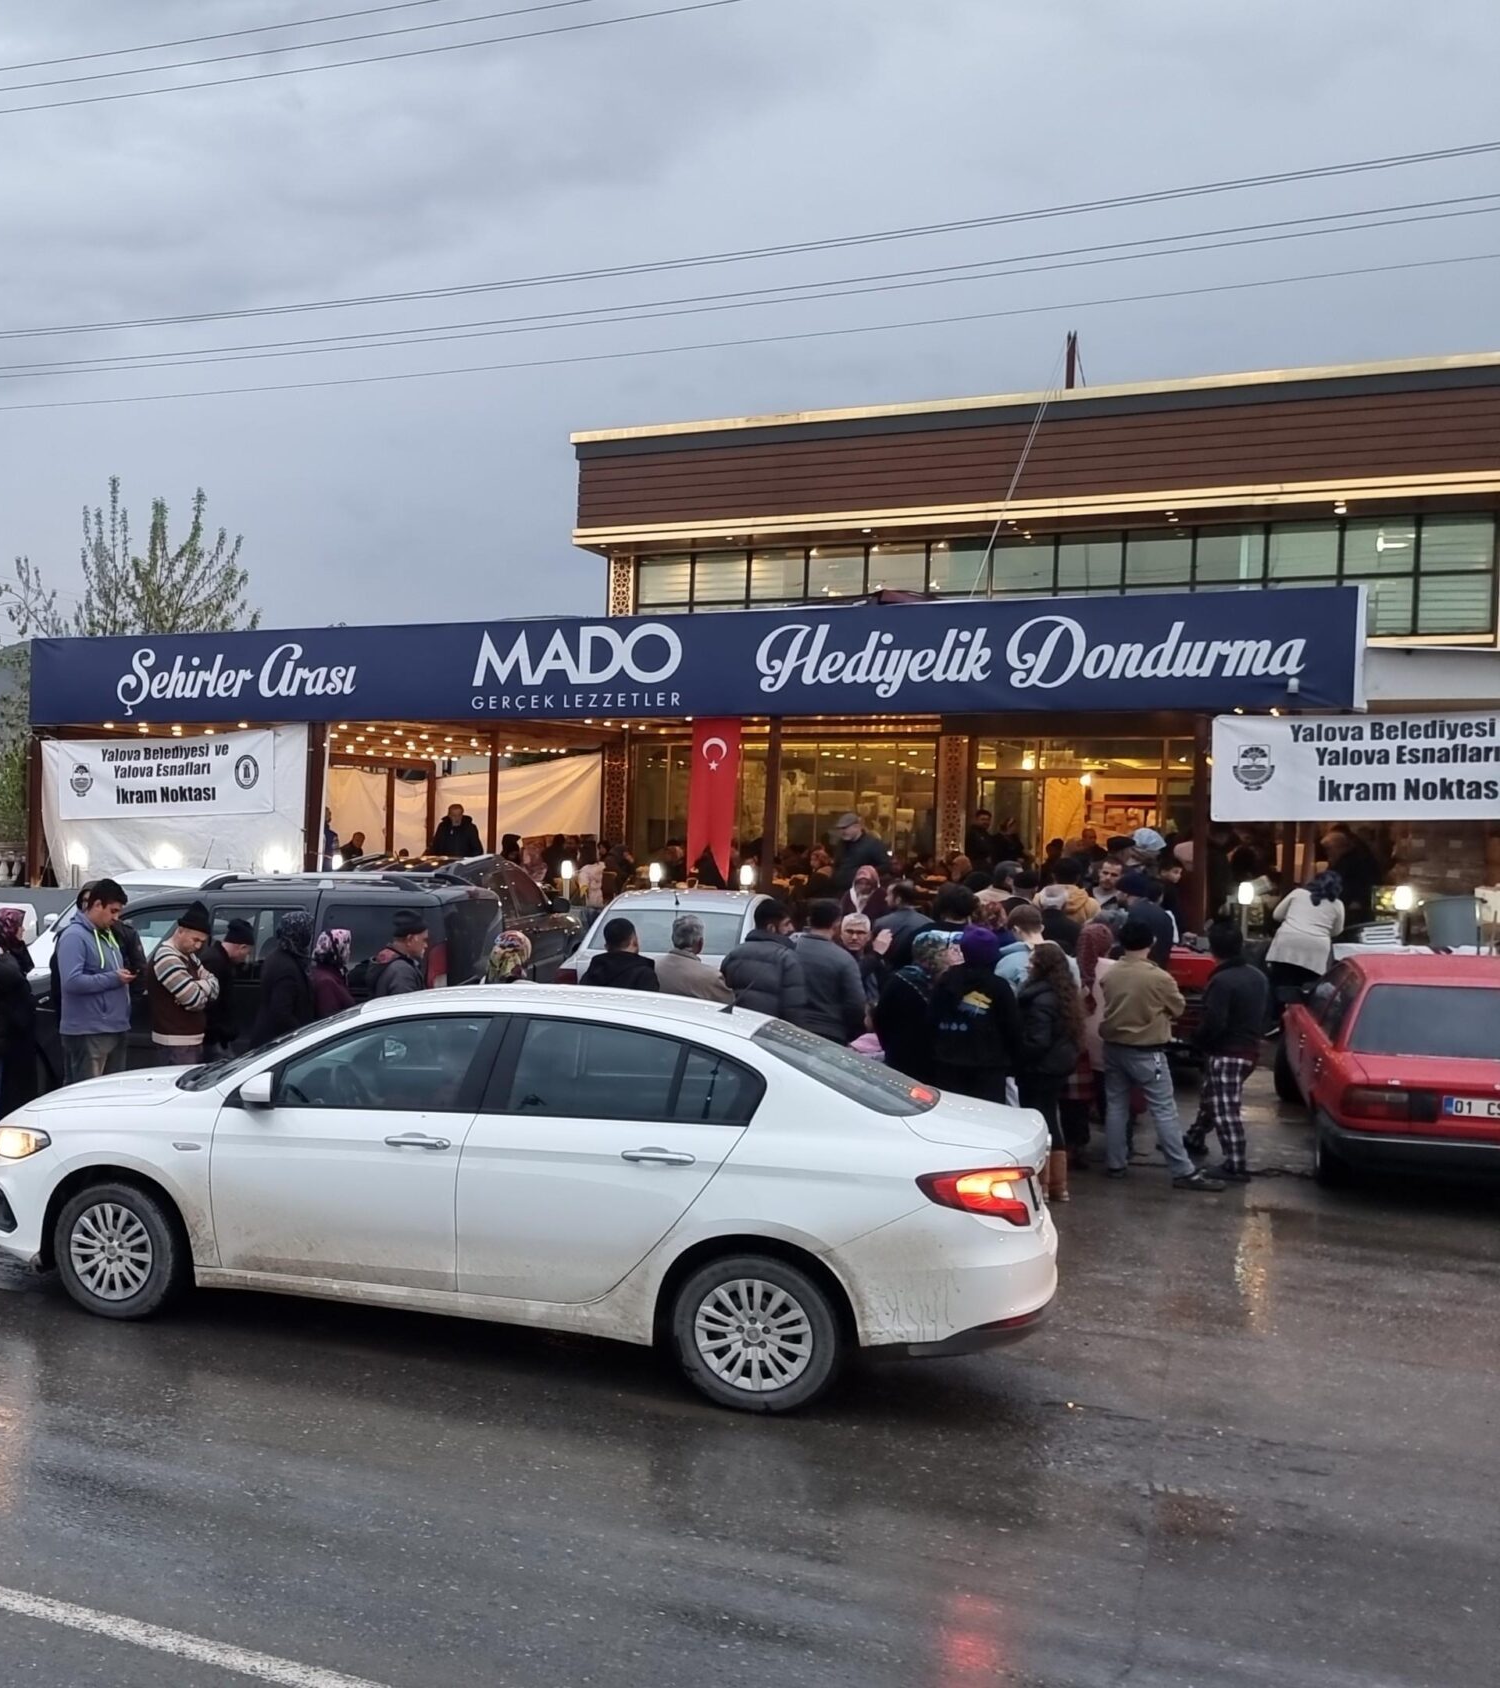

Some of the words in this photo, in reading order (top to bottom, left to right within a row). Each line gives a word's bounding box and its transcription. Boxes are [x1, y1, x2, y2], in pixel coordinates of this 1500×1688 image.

[472, 622, 683, 687] MADO
[755, 623, 992, 698] Hediyelik
[1005, 614, 1307, 689] Dondurma
[116, 648, 254, 716] Şehirler
[258, 643, 357, 698] Arası
[471, 694, 555, 711] GERÇEK
[563, 691, 681, 708] LEZZETLER
[1290, 724, 1364, 743] Yalova
[1370, 717, 1496, 741] Belediyesi
[101, 747, 142, 763] Yalova
[143, 743, 210, 761] Belediyesi
[214, 743, 230, 757] ve
[1315, 747, 1390, 766] Yalova
[114, 763, 153, 779] Yalova
[156, 762, 212, 778] Esnafları
[116, 785, 158, 805] İkram
[160, 785, 217, 804] Noktası
[1318, 775, 1397, 802] İkram
[1454, 1100, 1472, 1115] 01
